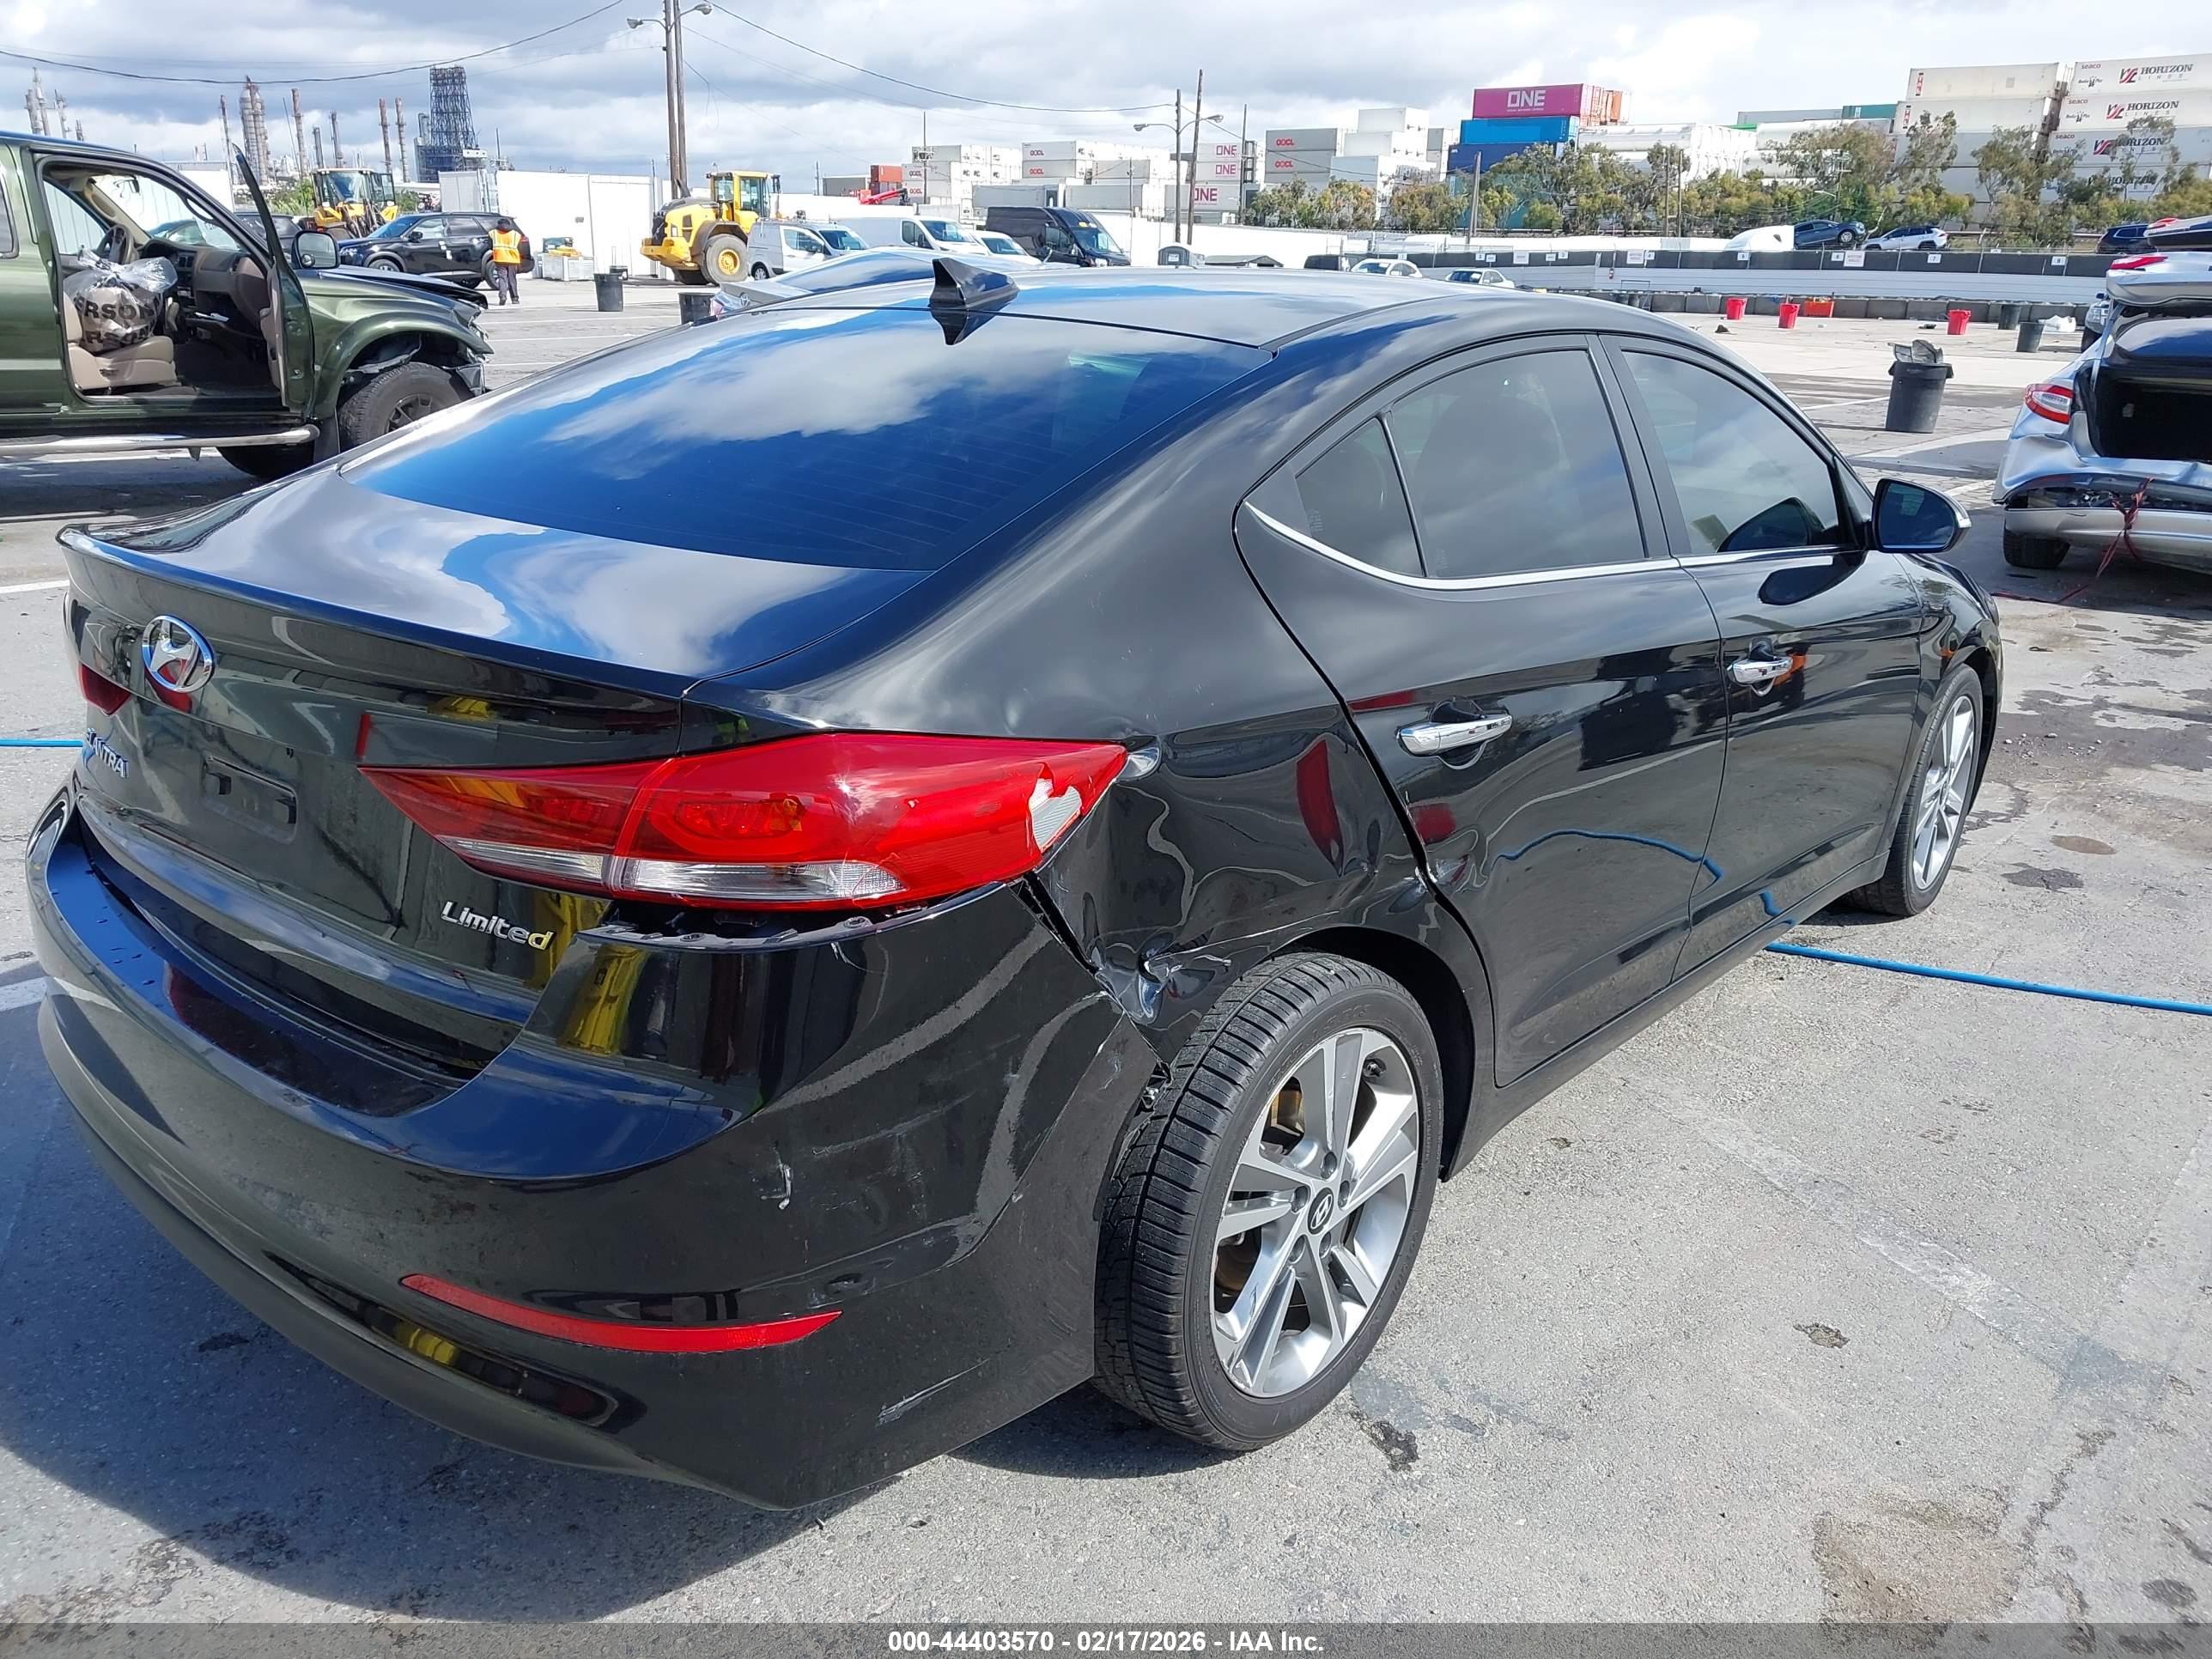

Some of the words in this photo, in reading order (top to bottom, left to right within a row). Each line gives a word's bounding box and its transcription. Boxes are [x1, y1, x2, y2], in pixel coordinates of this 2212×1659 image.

[2141, 64, 2194, 75] HORIZON
[1507, 89, 1547, 107] ONE
[2126, 100, 2179, 111] HORIZON
[2116, 137, 2164, 147] ORIZON
[1216, 145, 1237, 155] ONE
[1215, 164, 1236, 174] ONE
[441, 901, 555, 951] Limited
